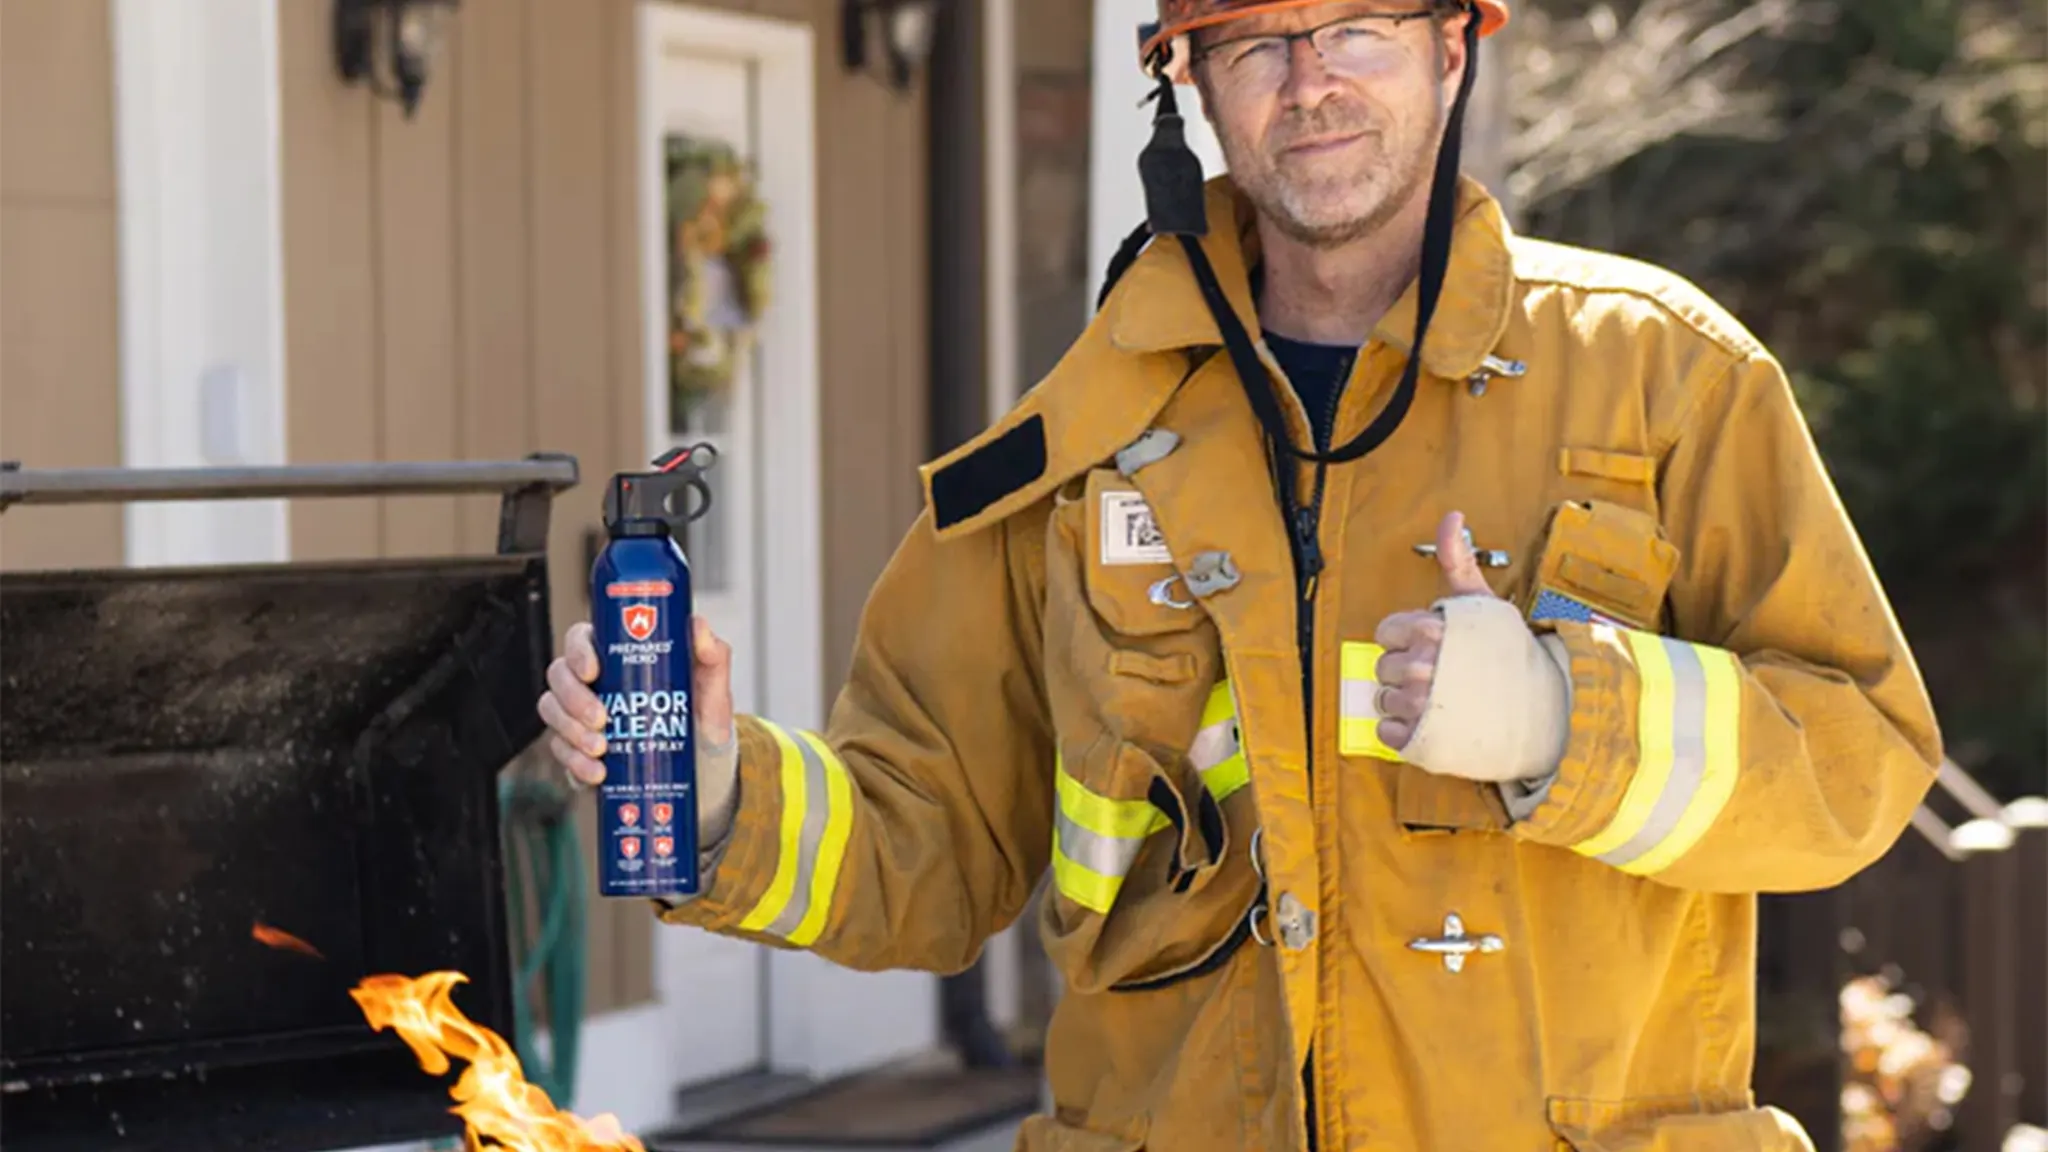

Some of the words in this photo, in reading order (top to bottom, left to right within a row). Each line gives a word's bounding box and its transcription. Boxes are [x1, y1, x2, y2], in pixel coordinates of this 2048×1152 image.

[609, 643, 671, 654] PREPARED
[622, 654, 658, 664] HERO
[601, 691, 688, 714] VAPOR
[608, 741, 633, 753] IRE
[638, 741, 685, 752] SPRAY
